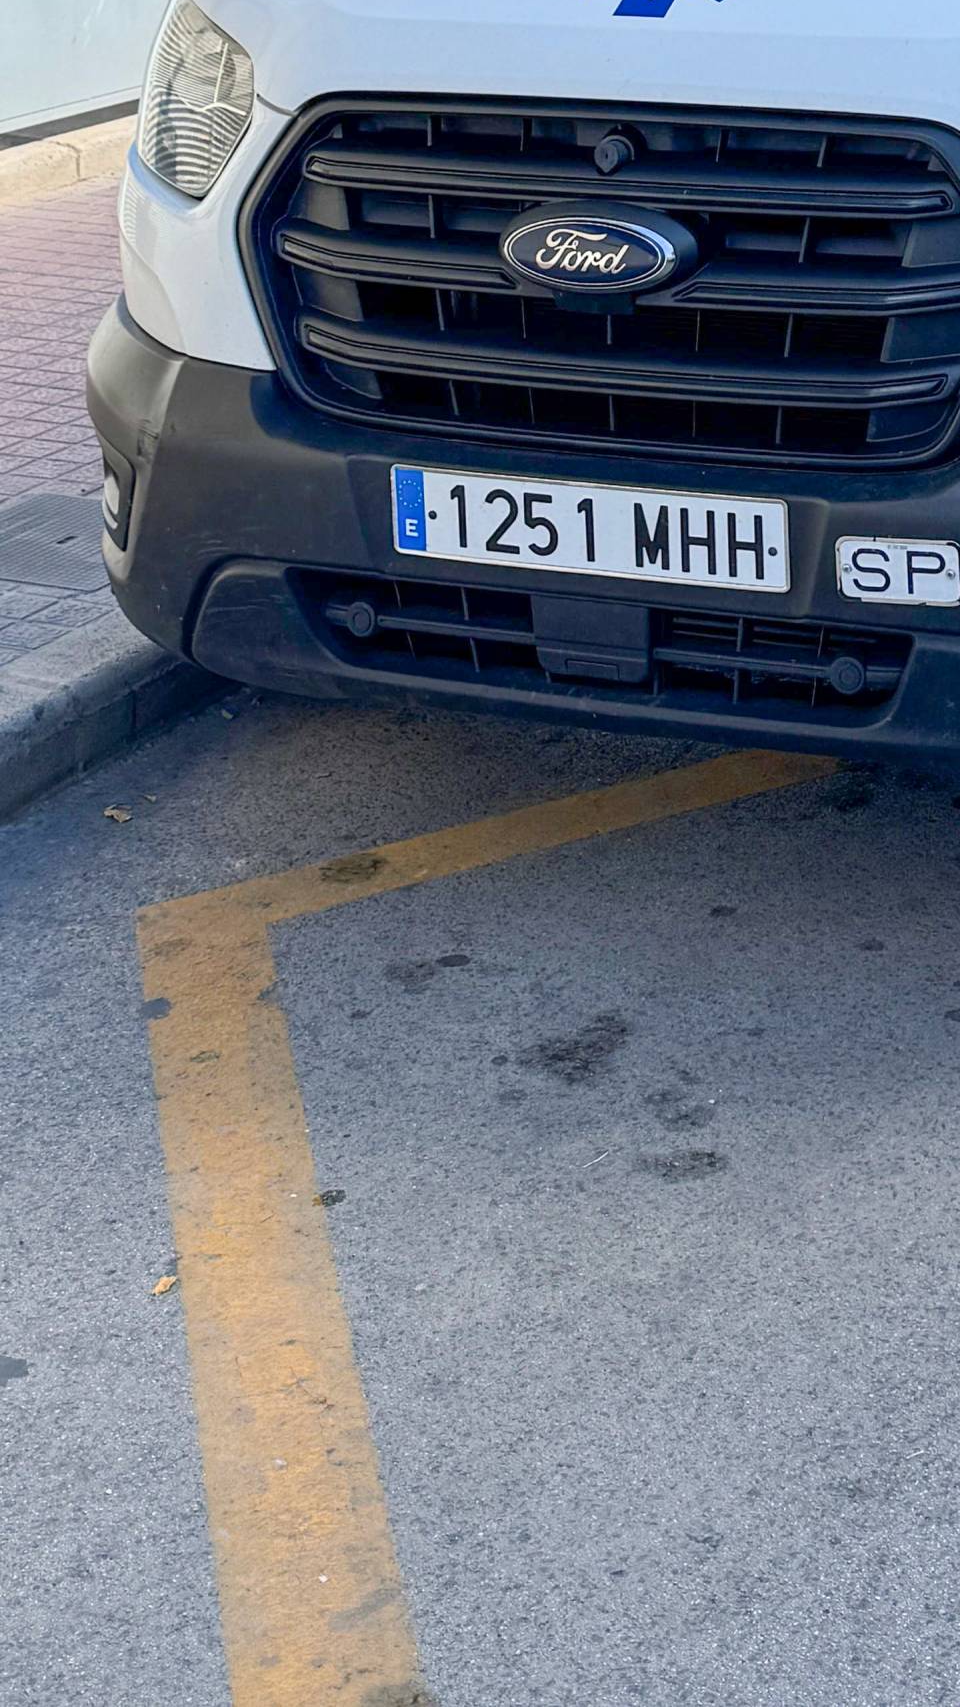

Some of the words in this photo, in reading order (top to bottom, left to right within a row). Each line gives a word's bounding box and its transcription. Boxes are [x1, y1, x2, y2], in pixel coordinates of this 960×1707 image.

[535, 228, 630, 275] Ford
[405, 518, 419, 537] E
[449, 484, 597, 563] 1251
[633, 502, 765, 580] MHH
[851, 547, 946, 595] SP
